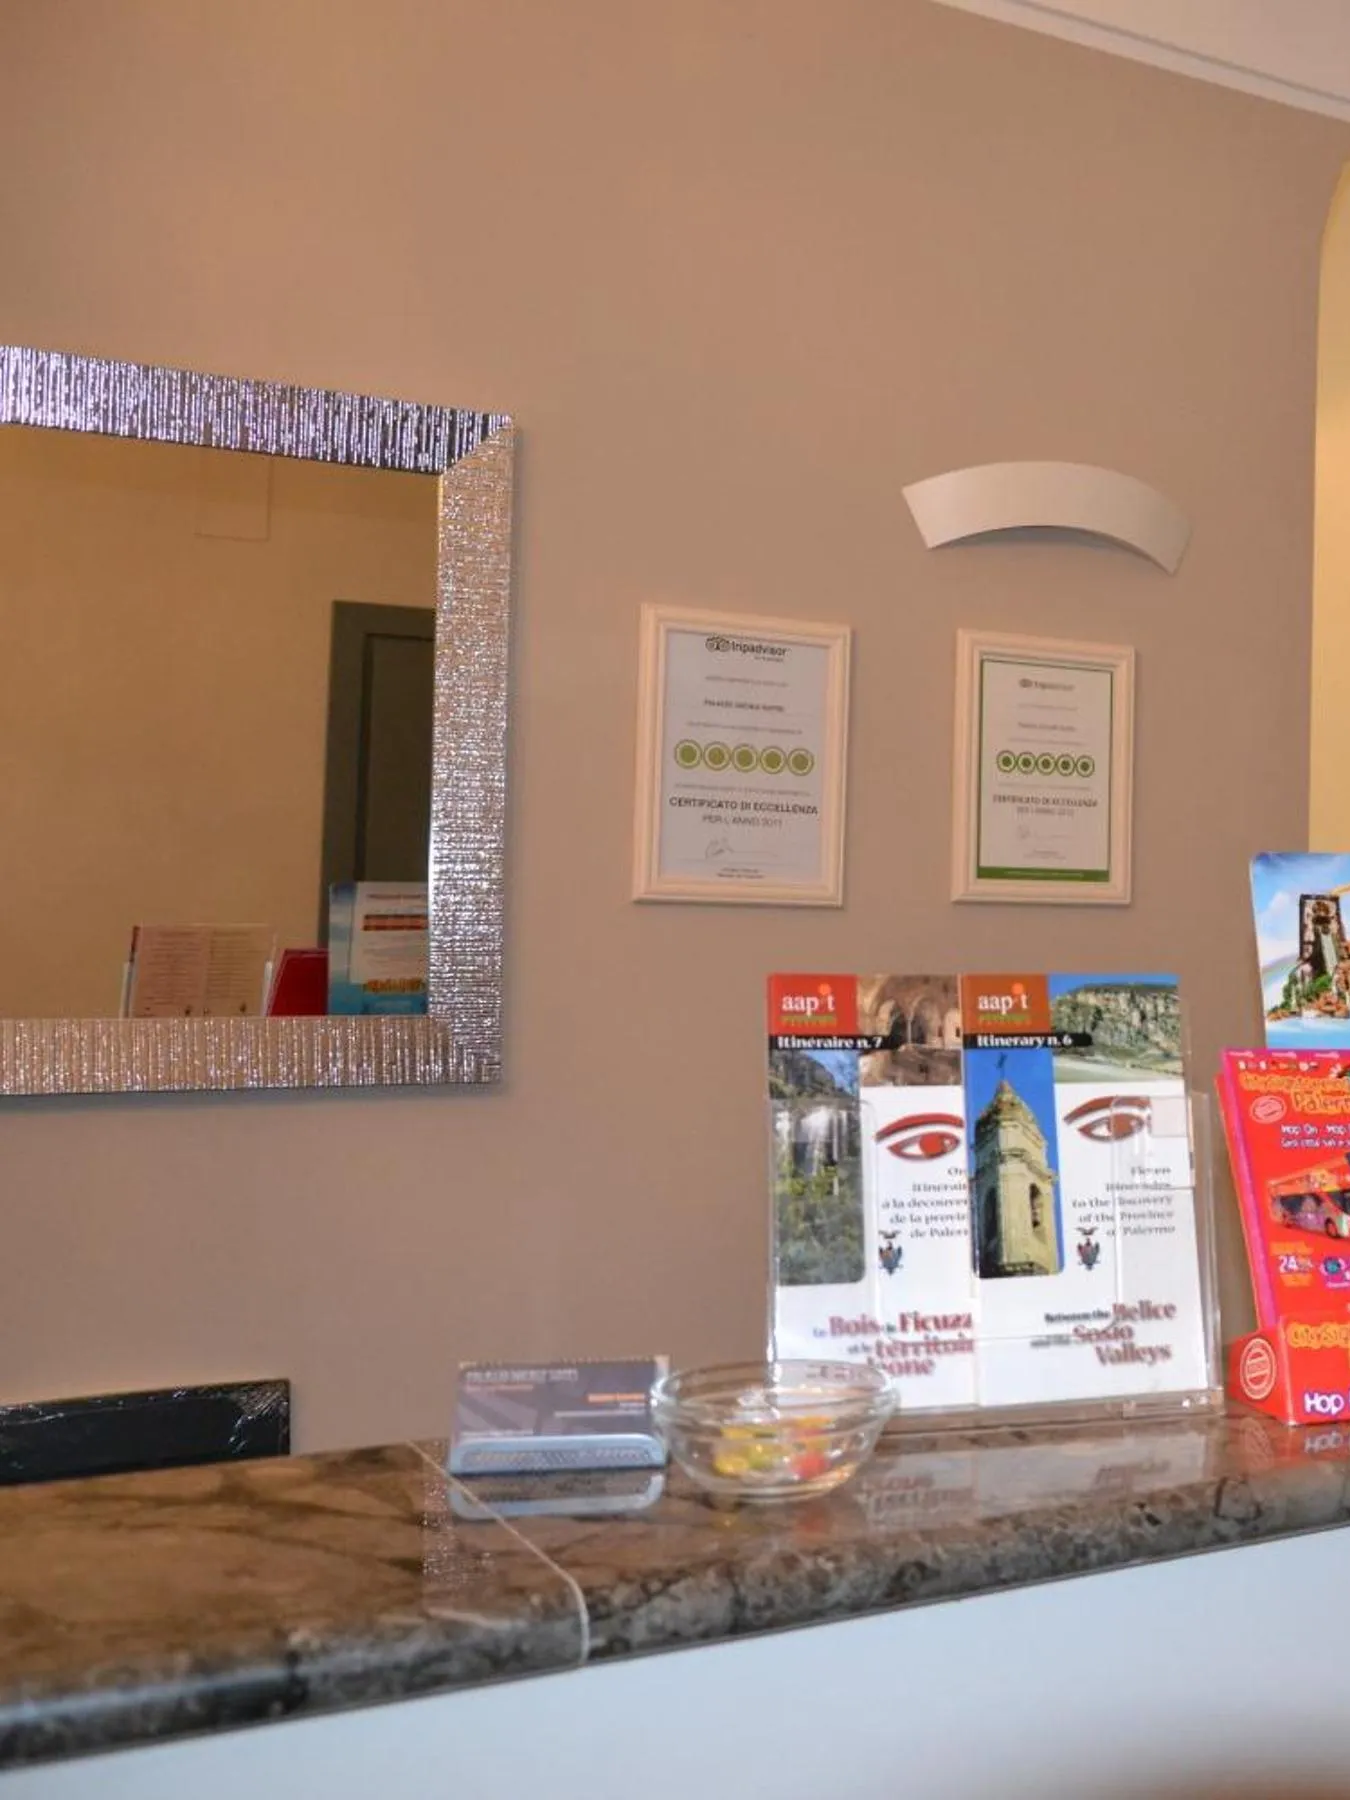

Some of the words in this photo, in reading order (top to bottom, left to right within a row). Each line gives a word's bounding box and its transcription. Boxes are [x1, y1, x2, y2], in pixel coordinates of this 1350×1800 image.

[668, 797, 737, 811] CERTIFICATO
[753, 802, 819, 815] ECCELLENZA
[873, 1036, 883, 1049] 7
[977, 1034, 1044, 1050] Itinerary
[1062, 1034, 1073, 1046] 6
[1112, 1299, 1177, 1321] Belice
[829, 1313, 882, 1337] Bois
[1095, 1341, 1172, 1367] Valleys
[1303, 1392, 1345, 1416] Hop
